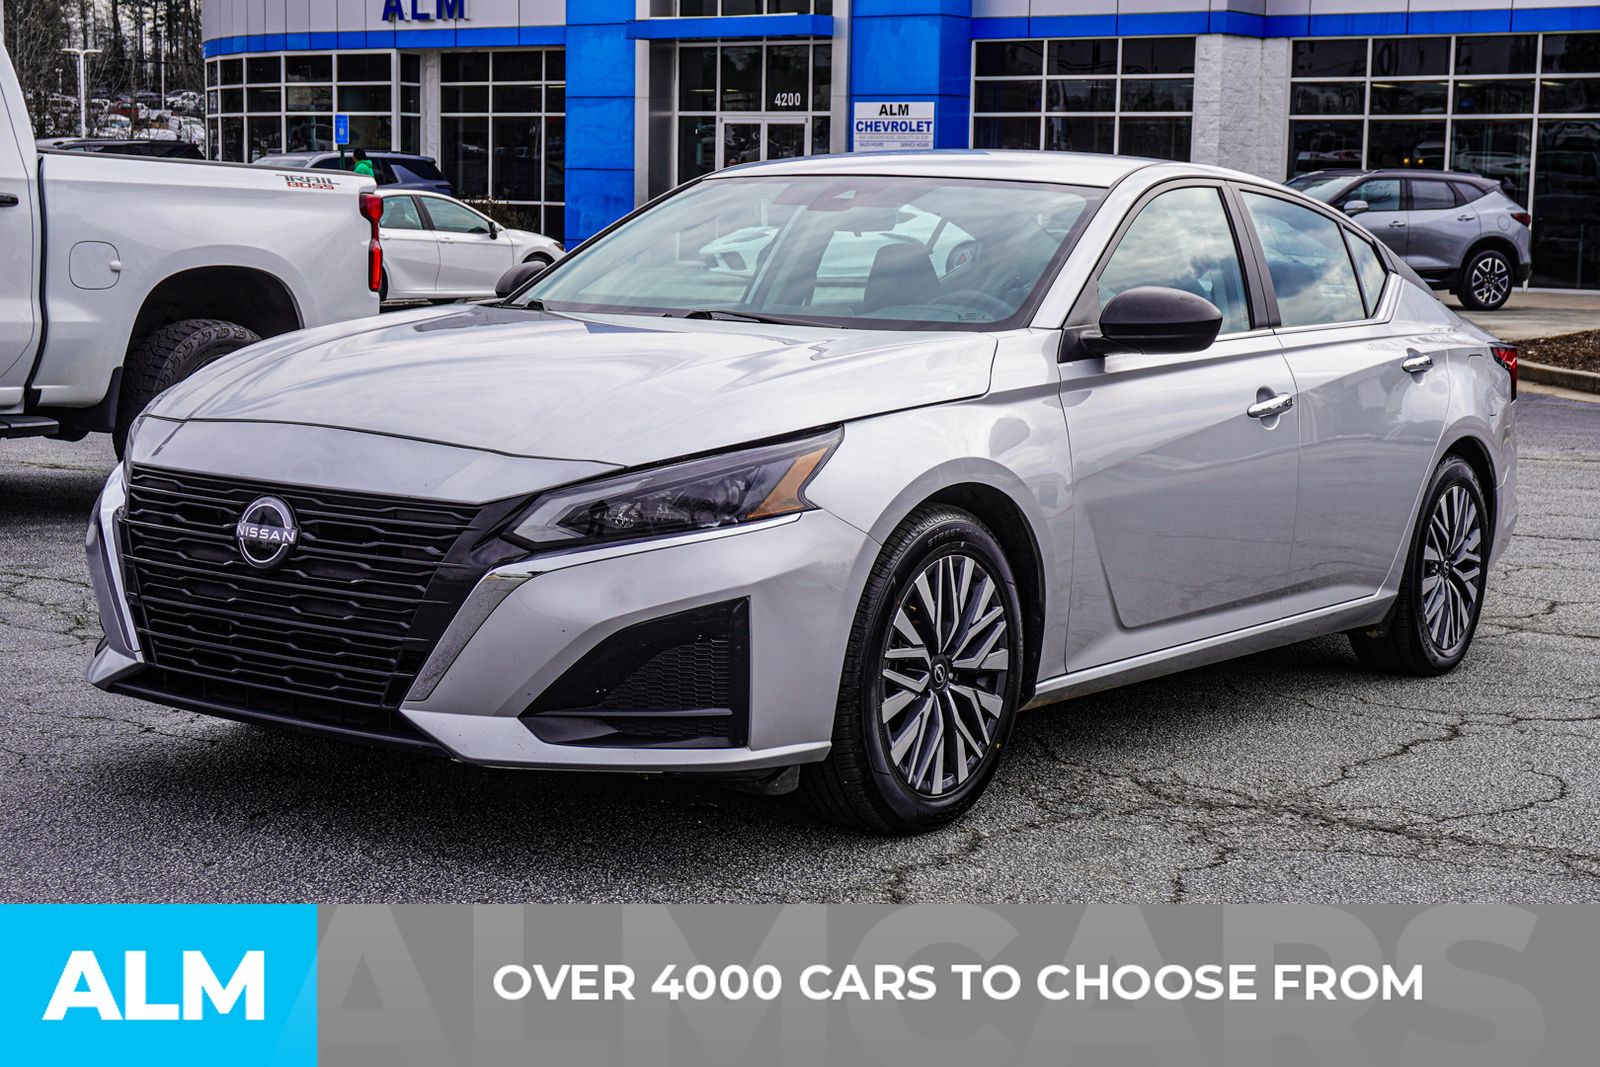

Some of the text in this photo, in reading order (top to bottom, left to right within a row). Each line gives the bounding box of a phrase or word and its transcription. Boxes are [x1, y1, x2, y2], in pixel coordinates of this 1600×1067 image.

[382, 0, 465, 21] ALM
[774, 92, 801, 106] 4200
[879, 104, 909, 116] ALM
[855, 120, 933, 132] CHEVROLET
[275, 173, 341, 186] TRAIL
[287, 181, 335, 190] BOSS
[236, 525, 295, 542] NISSAN
